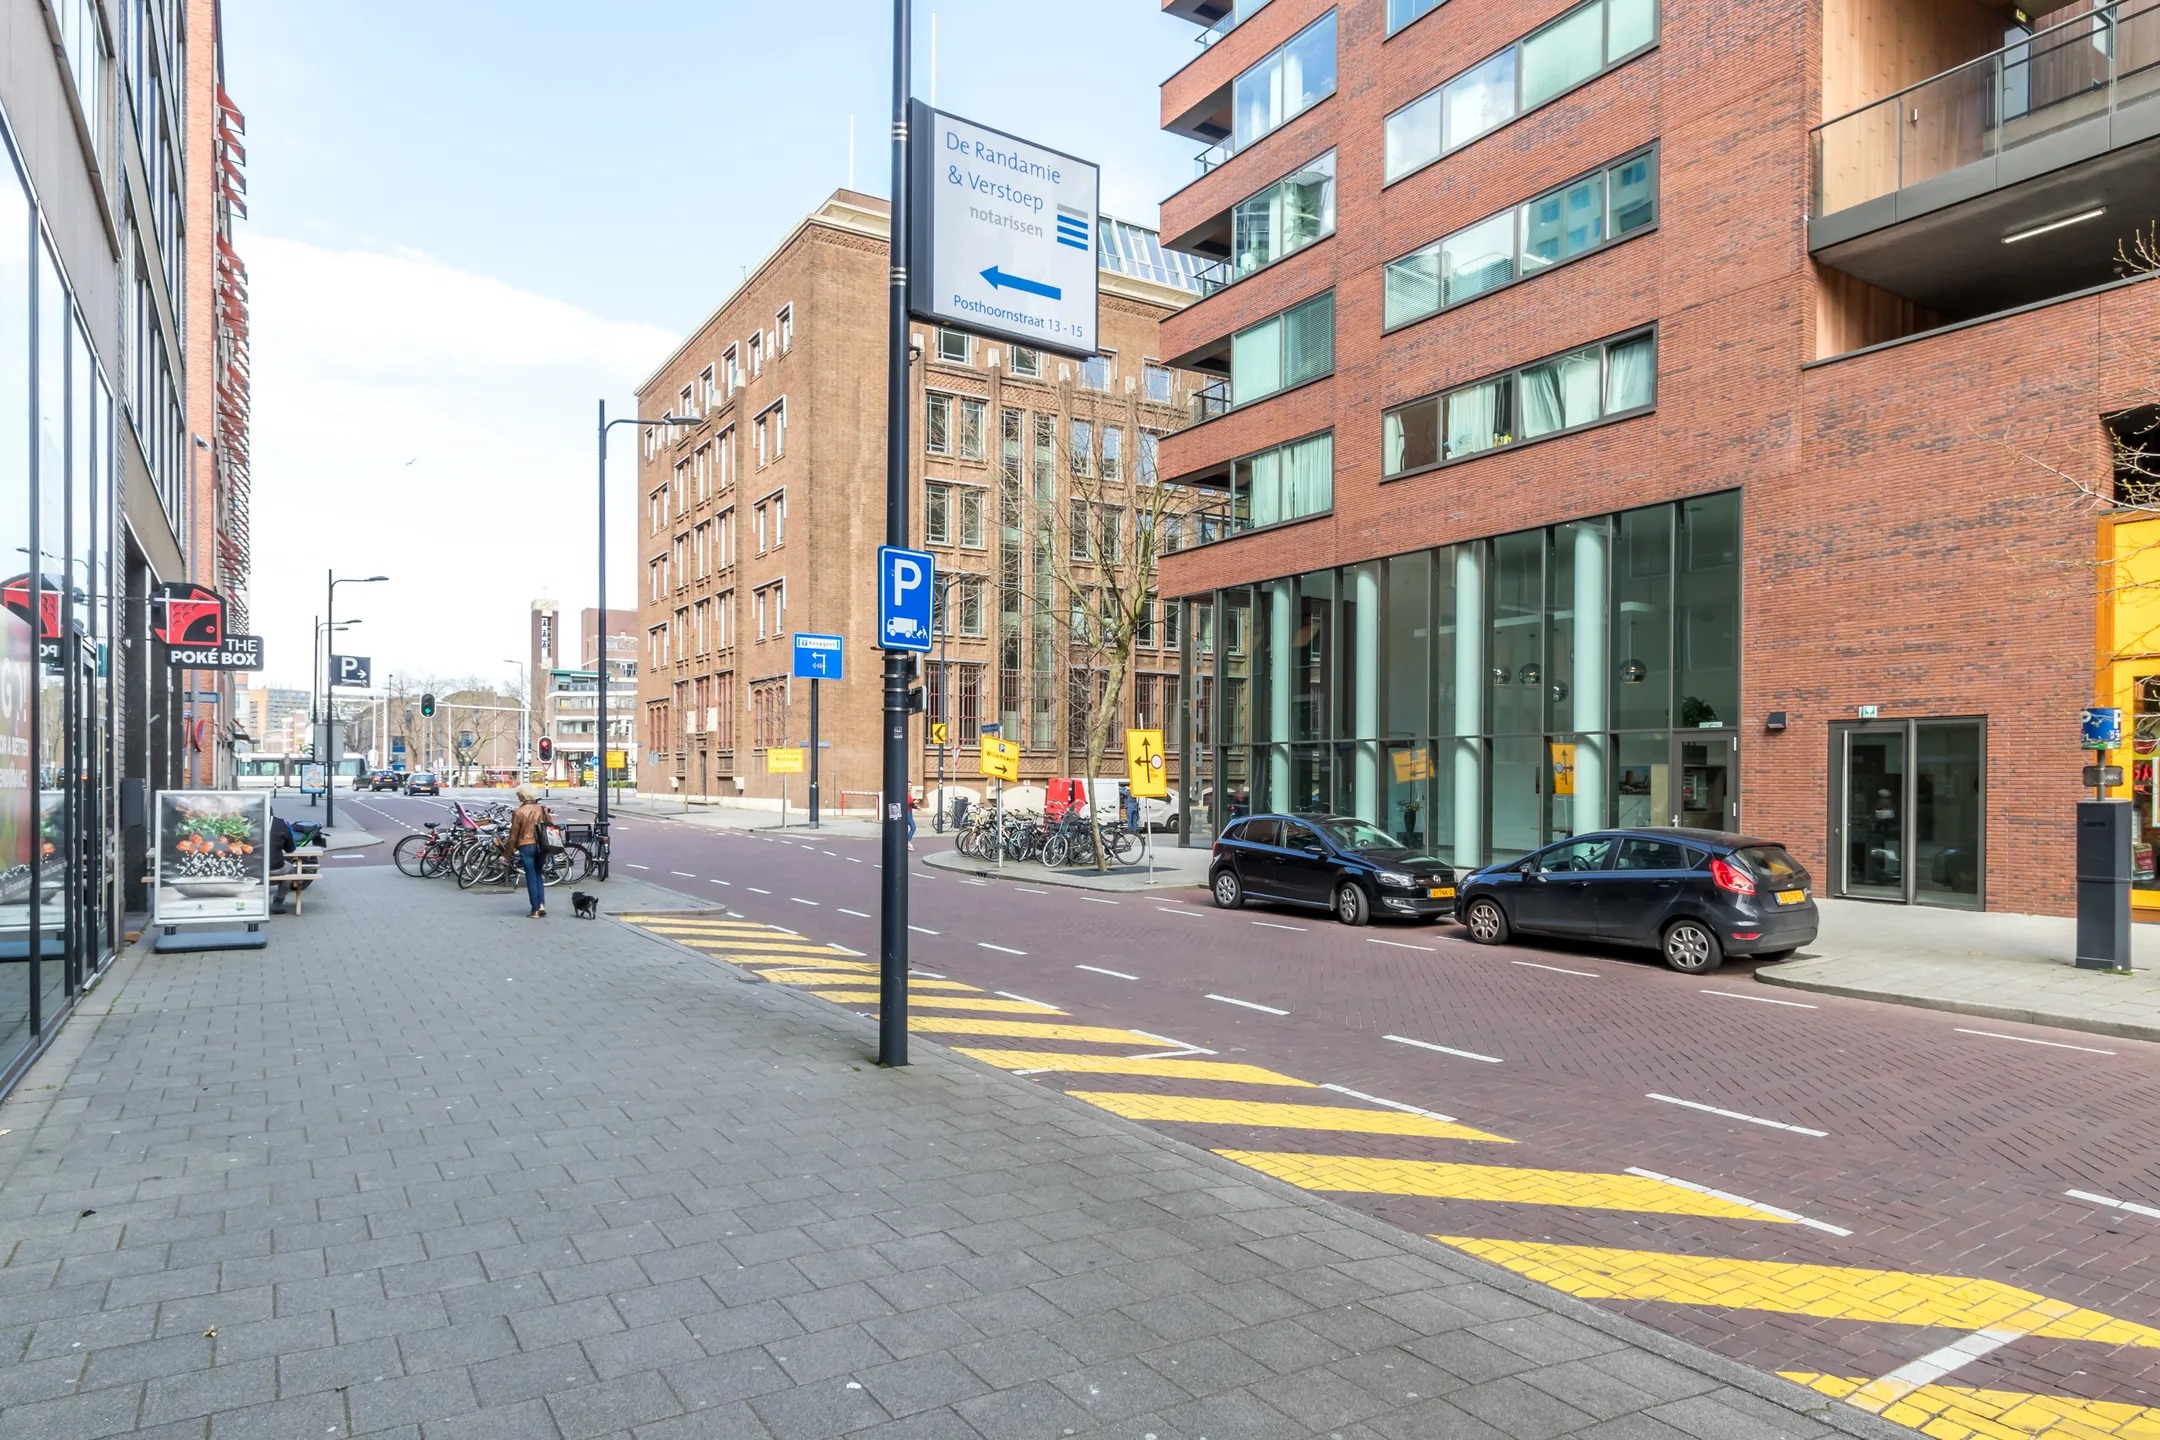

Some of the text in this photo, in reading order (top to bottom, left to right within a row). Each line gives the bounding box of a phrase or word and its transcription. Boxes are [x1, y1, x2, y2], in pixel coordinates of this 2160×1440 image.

[946, 131, 1061, 184] De Randamie
[948, 165, 1044, 215] & Verstoep
[969, 206, 1043, 238] notarissen
[953, 294, 1045, 329] Posthoornstraat
[1048, 319, 1061, 332] 13
[1071, 324, 1084, 338] 15
[894, 558, 922, 607] P
[170, 647, 257, 666] POKÉ BOX
[225, 638, 258, 652] THE
[341, 656, 358, 678] P
